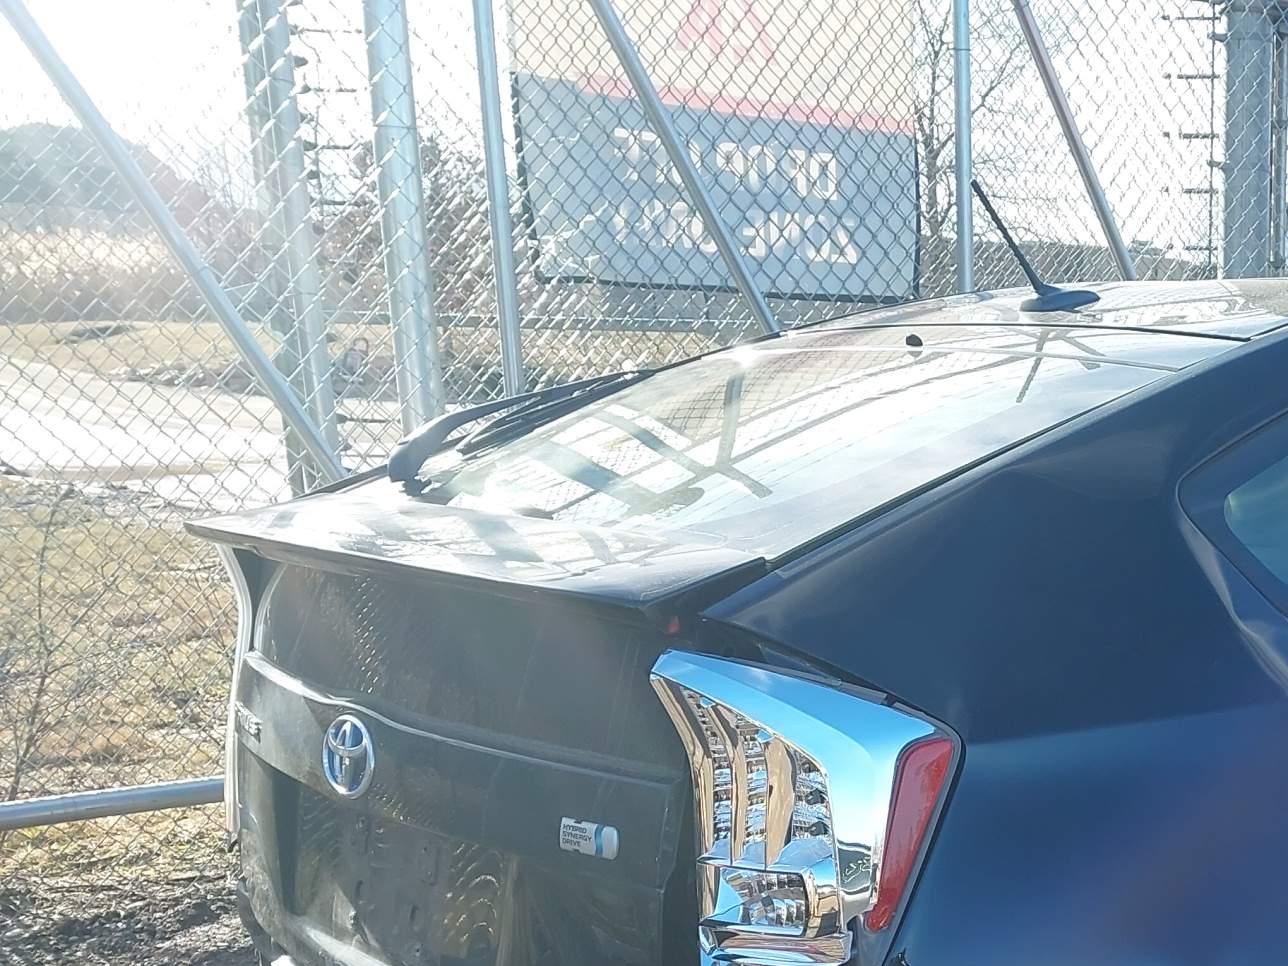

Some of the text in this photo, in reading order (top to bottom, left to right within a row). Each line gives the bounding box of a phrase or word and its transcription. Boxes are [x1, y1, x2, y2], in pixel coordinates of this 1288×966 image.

[562, 823, 588, 834] HYBRID
[561, 837, 582, 847] DRIVE
[562, 831, 592, 843] SYNERGY
